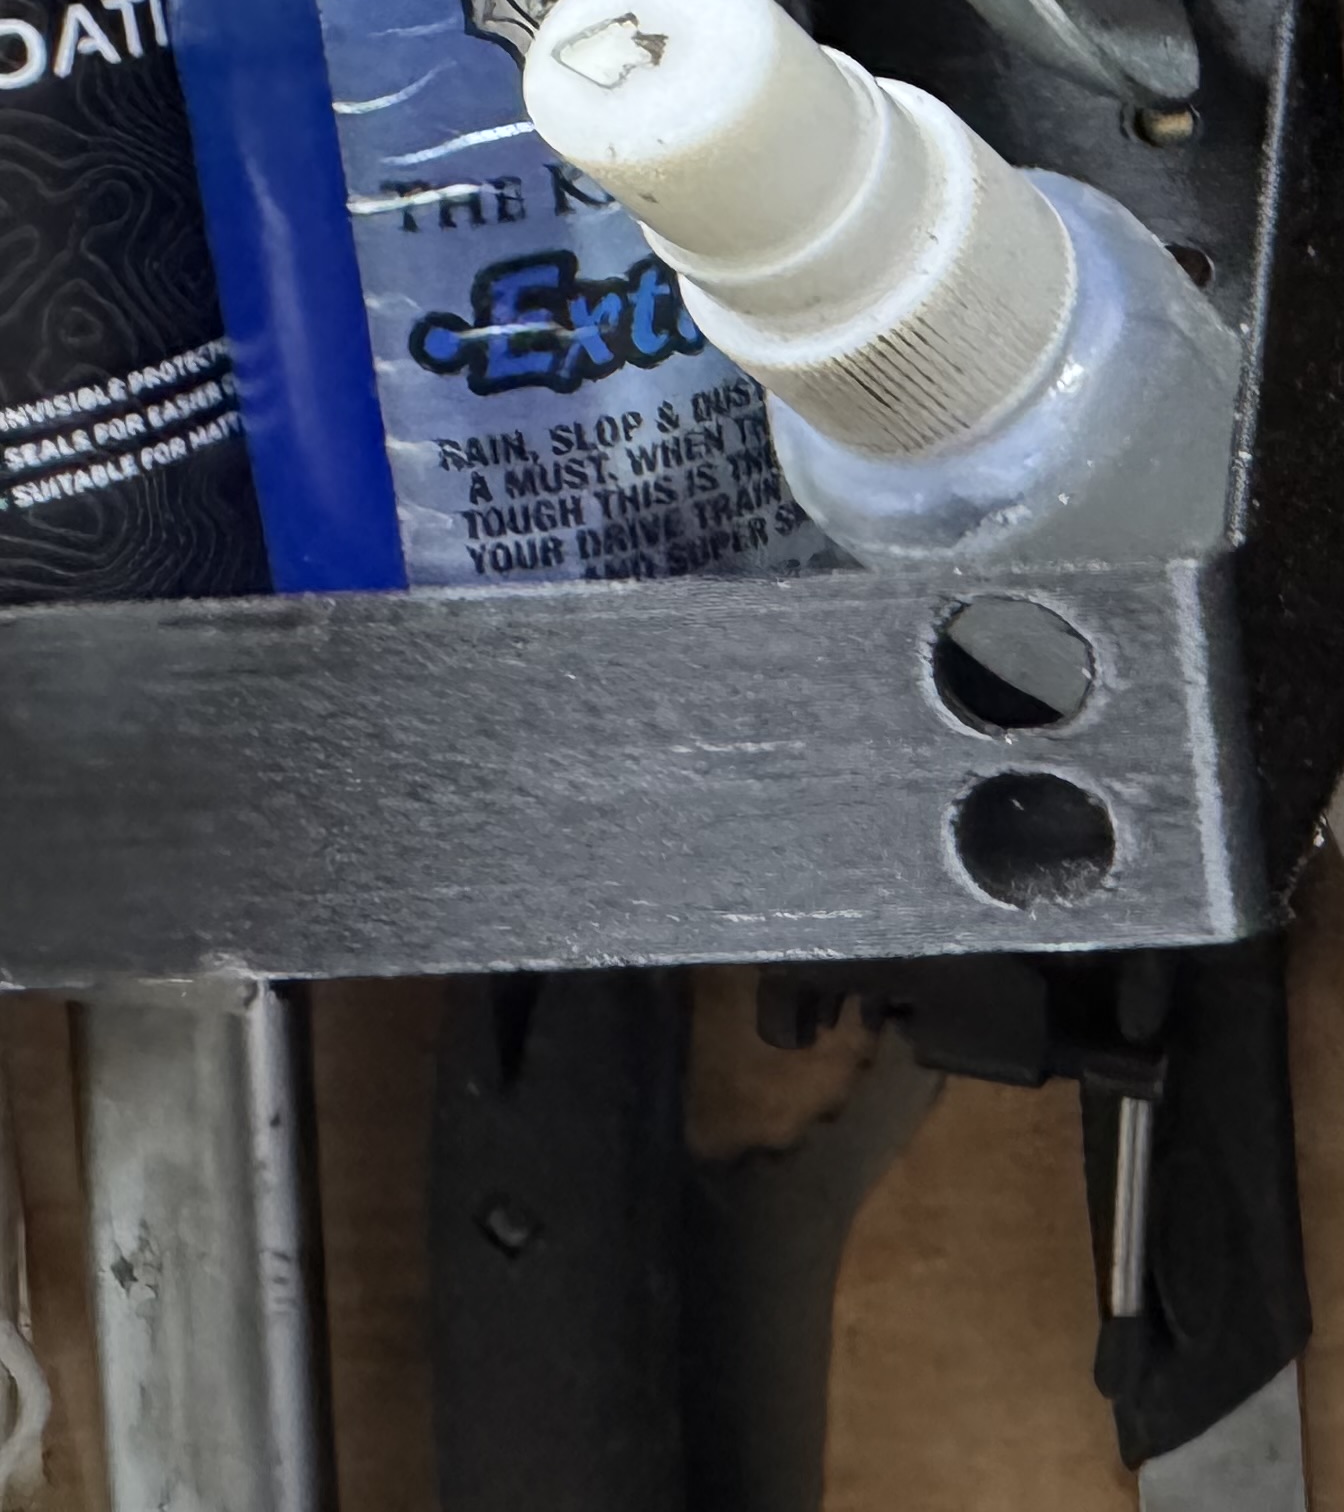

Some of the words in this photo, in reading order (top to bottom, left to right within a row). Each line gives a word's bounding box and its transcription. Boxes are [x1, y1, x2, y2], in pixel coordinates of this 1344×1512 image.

[467, 249, 706, 397] Ext
[549, 410, 644, 456] SLOP
[469, 471, 494, 505] A
[625, 422, 726, 477] WHEN
[457, 494, 586, 540] TOUGH
[465, 535, 565, 576] YOUR
